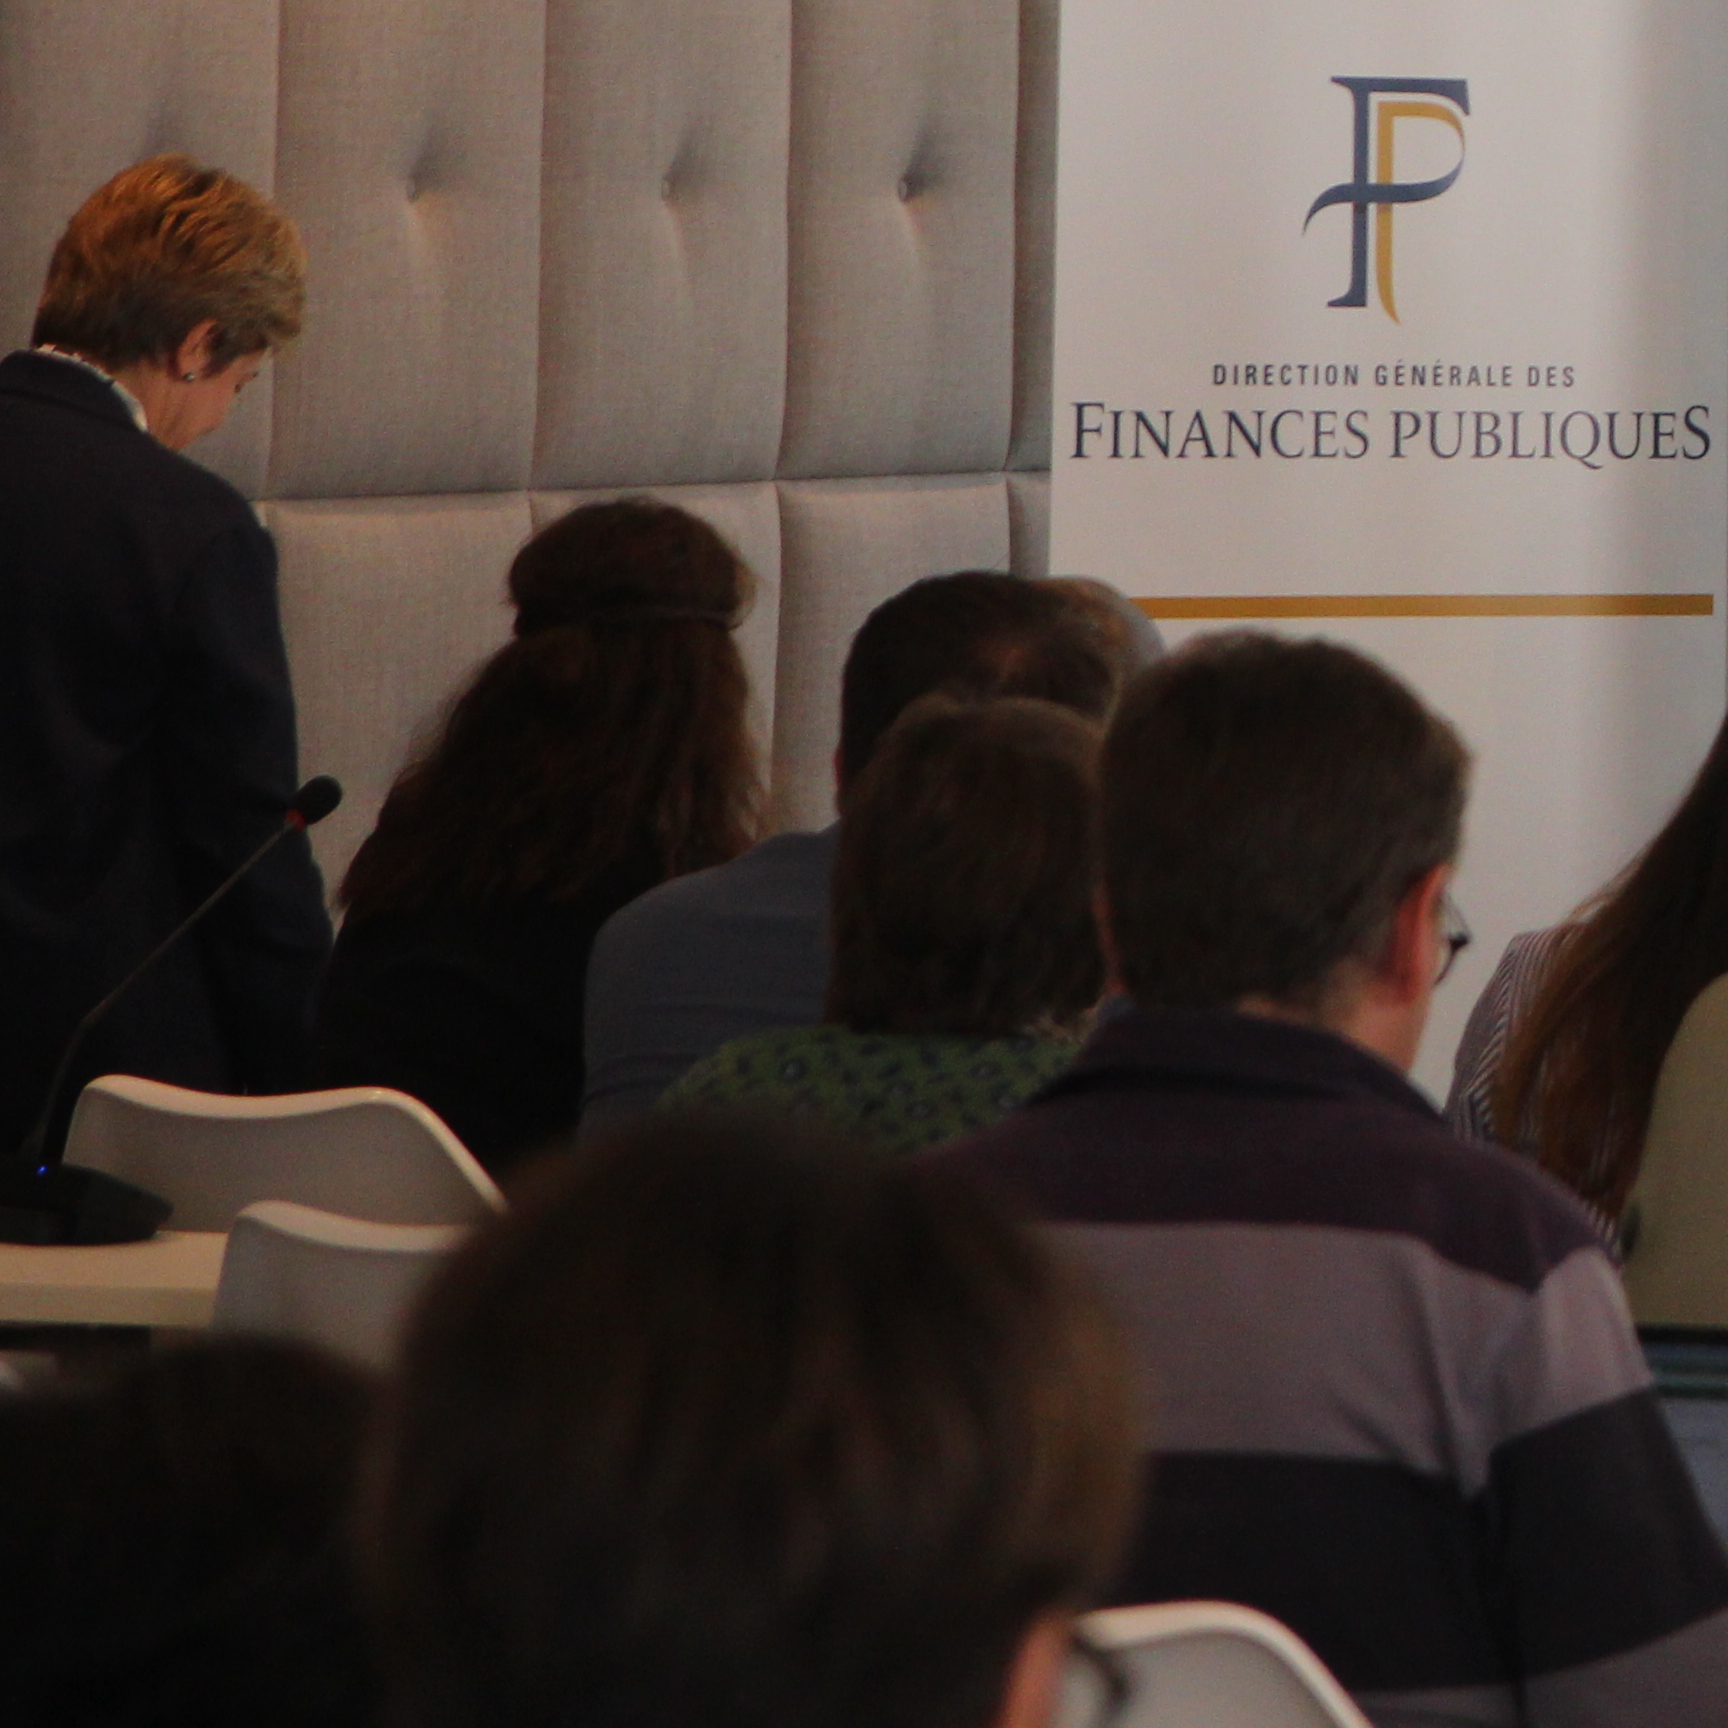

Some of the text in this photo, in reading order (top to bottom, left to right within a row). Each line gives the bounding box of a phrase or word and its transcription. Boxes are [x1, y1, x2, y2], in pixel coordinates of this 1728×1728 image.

[1211, 359, 1575, 389] DIRECTION GÉNÉRALE DES
[1070, 402, 1712, 470] FINANCES PUBLIQUES
